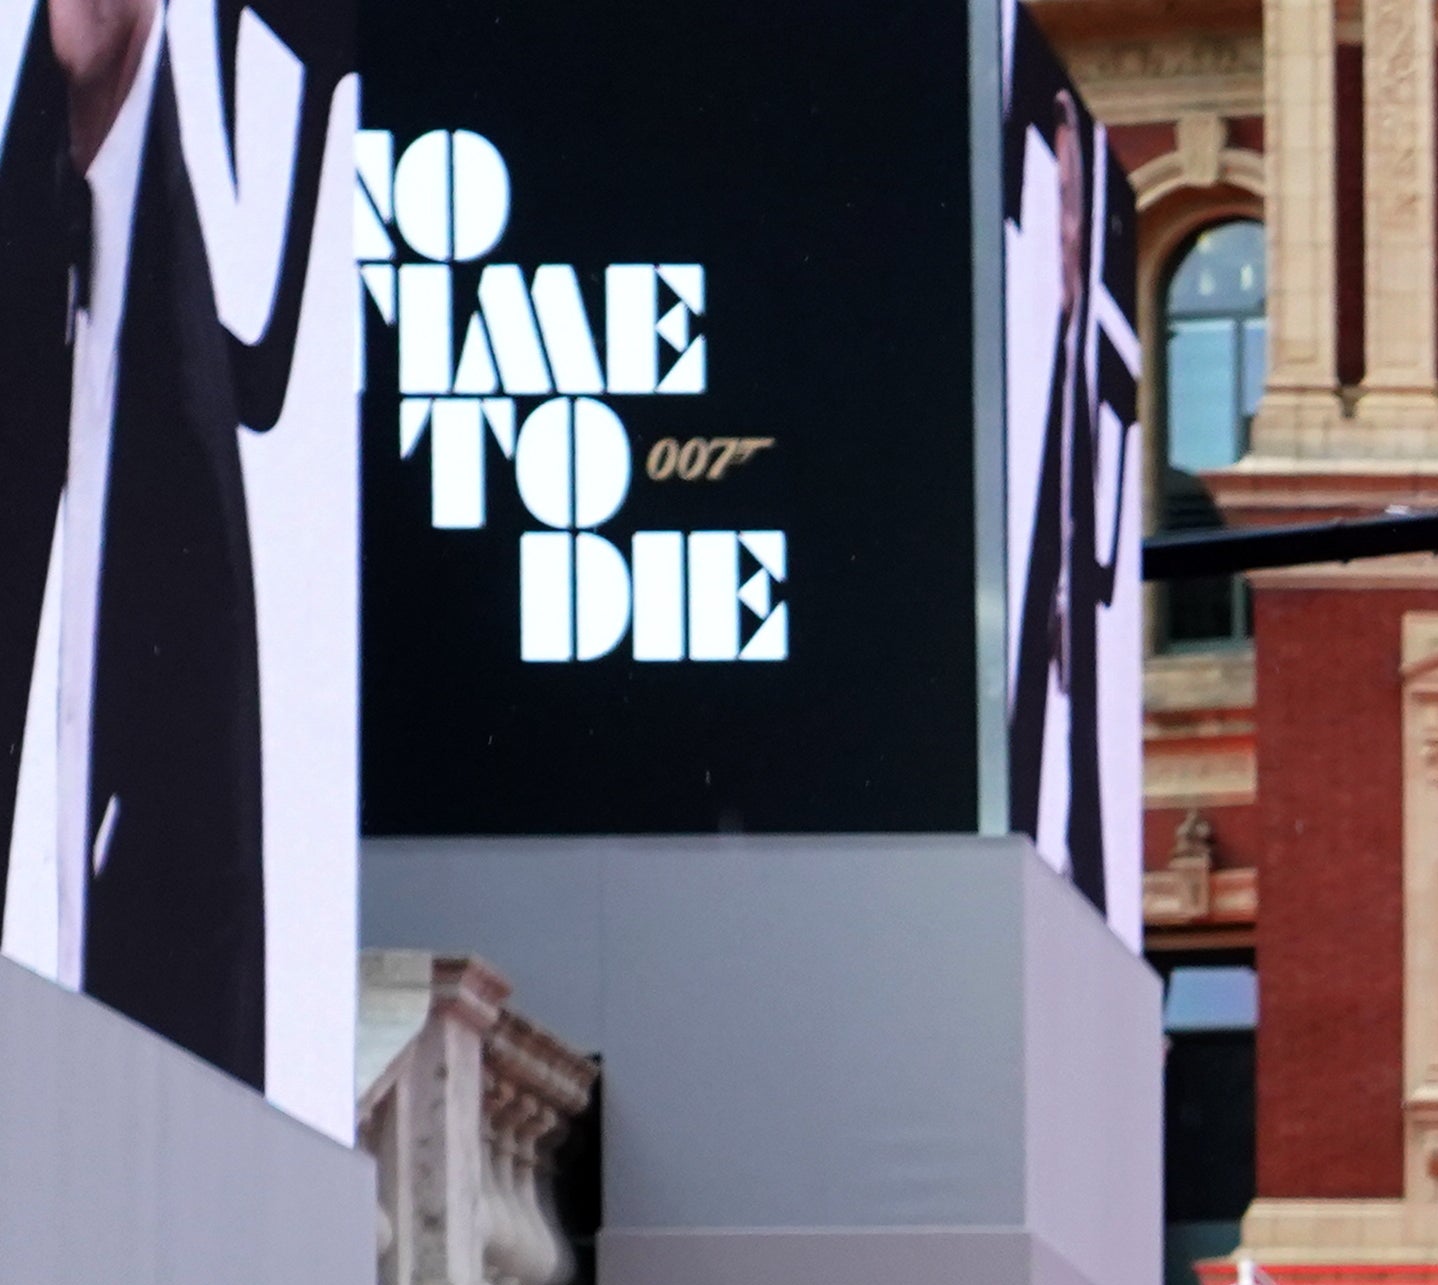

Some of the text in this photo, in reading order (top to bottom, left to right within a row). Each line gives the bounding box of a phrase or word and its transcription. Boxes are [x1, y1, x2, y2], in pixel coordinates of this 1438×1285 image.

[400, 397, 631, 529] TO
[646, 436, 758, 482] 007
[519, 530, 788, 662] DIE
